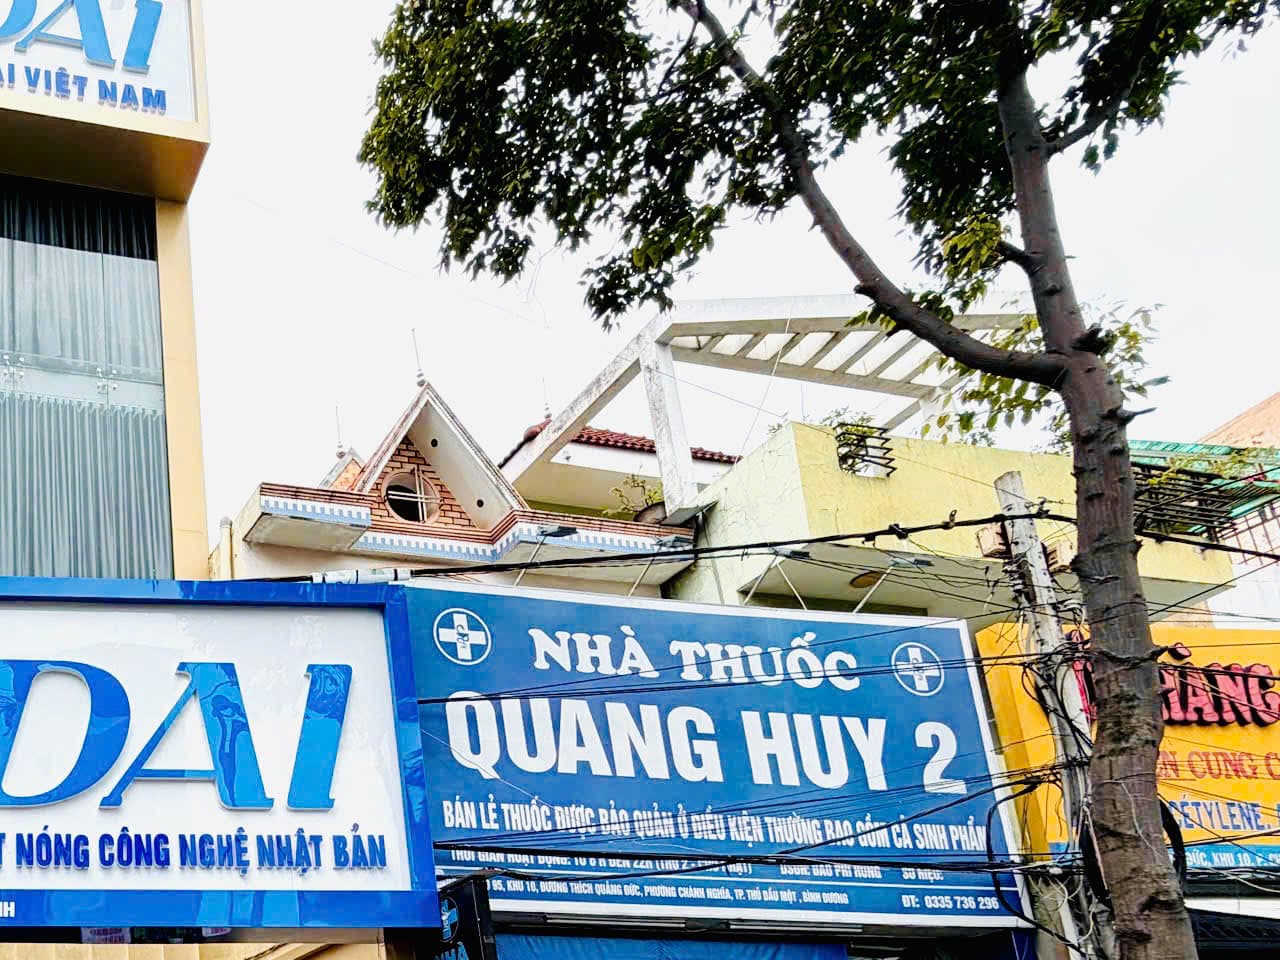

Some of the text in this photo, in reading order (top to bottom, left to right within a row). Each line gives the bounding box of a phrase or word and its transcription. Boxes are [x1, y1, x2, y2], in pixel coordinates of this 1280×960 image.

[98, 79, 166, 111] NAM
[527, 625, 861, 691] NHÀ THUỐC
[444, 690, 968, 794] QUANG HUY 2
[1187, 751, 1260, 780] CUNG
[442, 795, 477, 829] BÁN
[479, 793, 499, 830] LẺ
[500, 795, 552, 832] THUỐC
[554, 804, 596, 840] ĐƯỢC
[598, 799, 631, 836] BẢO
[632, 802, 676, 840] QUẢN
[727, 809, 765, 848] KIỆN
[764, 812, 822, 845] THƯỜNG
[824, 819, 855, 847] BAO
[855, 813, 891, 848] GỒM
[891, 814, 913, 849] CẢ
[913, 823, 949, 850] SINH
[15, 826, 89, 870] NÓNG
[98, 827, 170, 869] CÔNG
[179, 828, 249, 876] NGHỆ
[257, 829, 323, 875] NHẬT
[333, 824, 386, 870] BẢN
[506, 879, 524, 891] KHU
[525, 880, 539, 894] 10,
[569, 880, 594, 895] THÍCH
[594, 880, 622, 896] QUẢNG
[734, 888, 745, 900] TP.
[924, 895, 953, 909] 0335
[953, 896, 976, 909] 736
[977, 896, 1000, 910] 296
